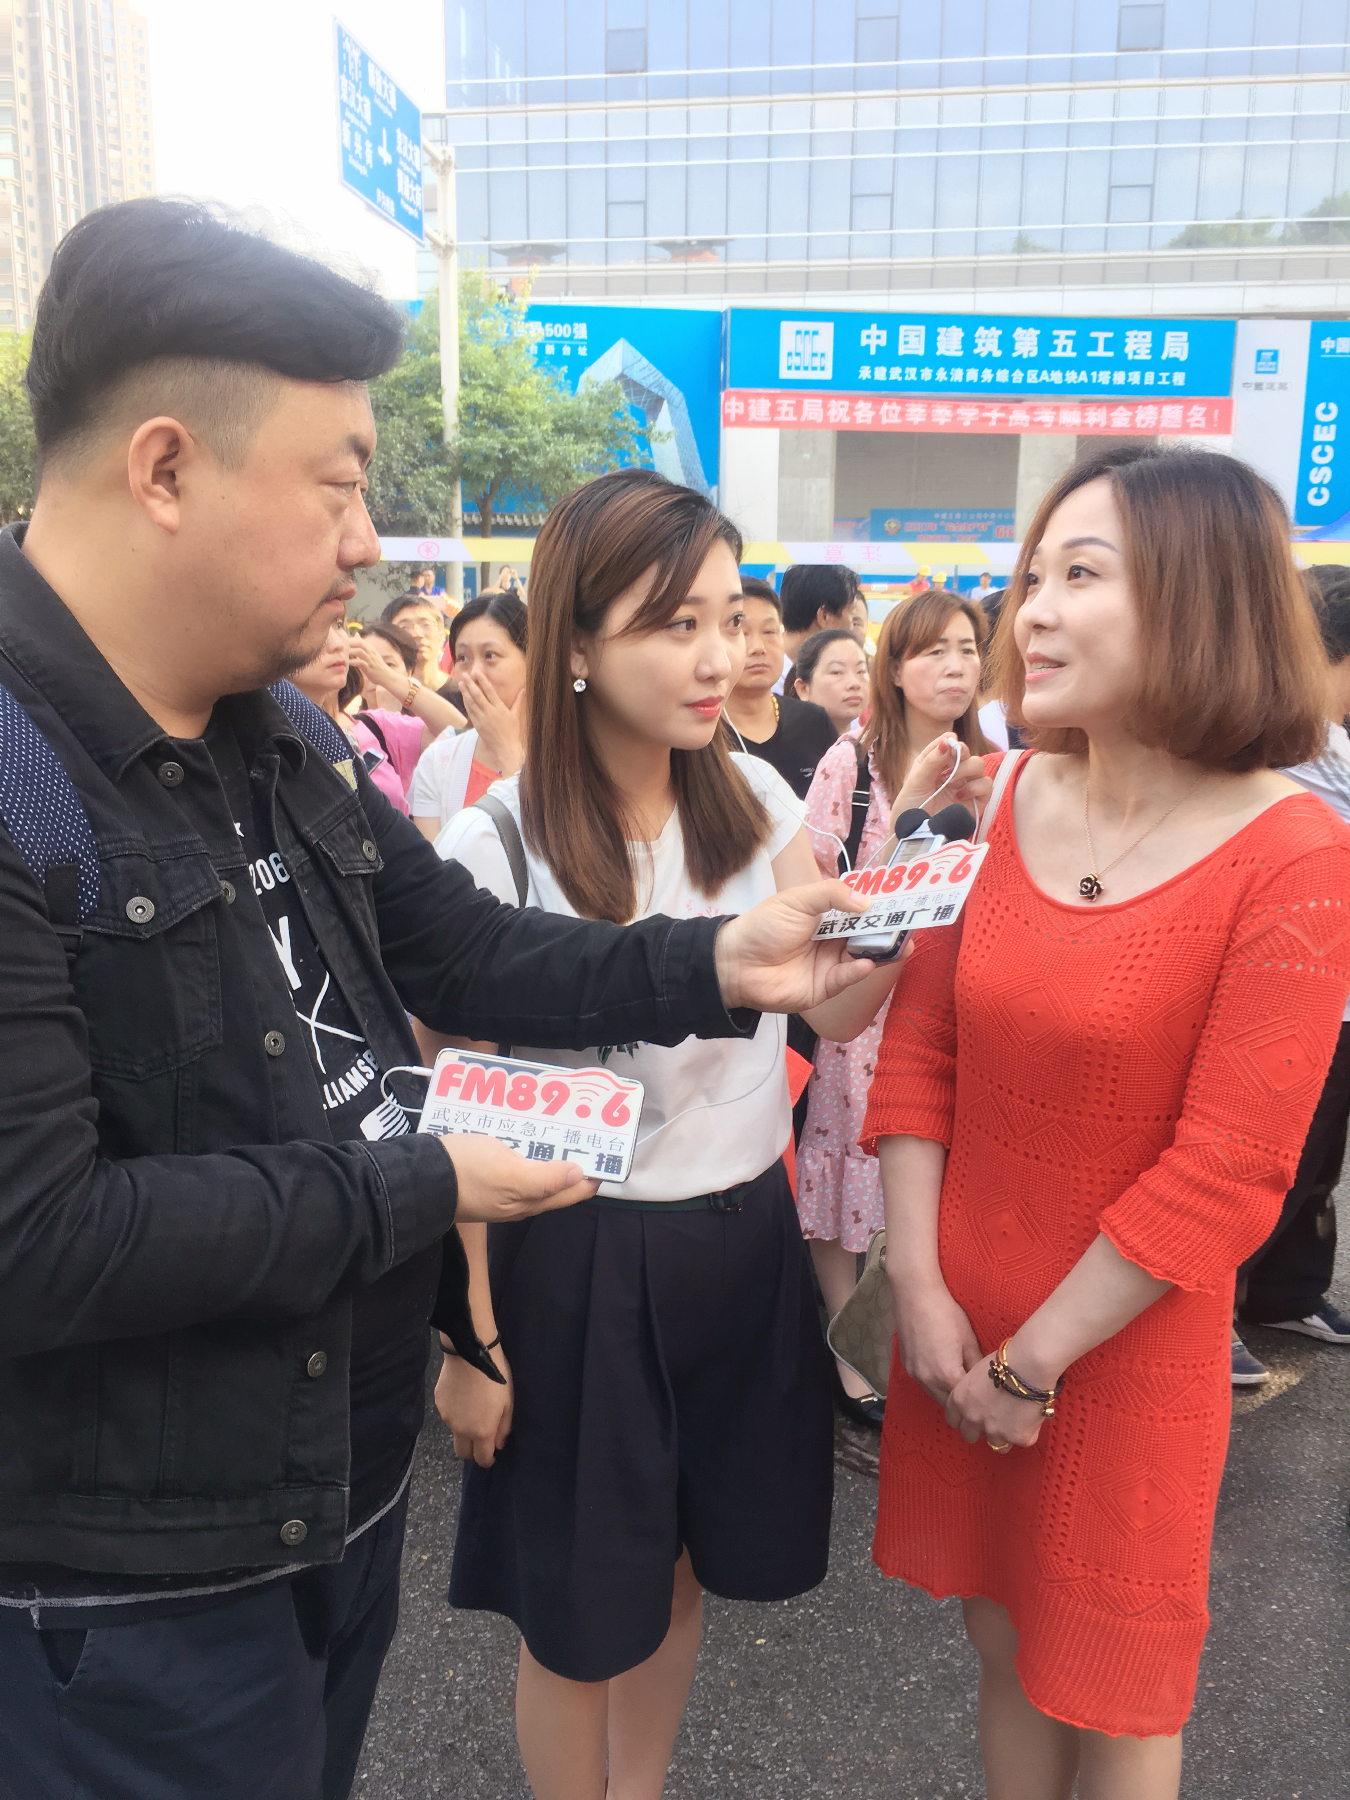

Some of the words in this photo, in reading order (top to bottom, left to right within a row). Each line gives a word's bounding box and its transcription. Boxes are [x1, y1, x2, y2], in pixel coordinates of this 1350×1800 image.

[860, 323, 1190, 361] 中国建筑第五工程局
[1307, 402, 1339, 506] CSCEC
[842, 853, 974, 896] FM89.6
[817, 904, 956, 935] 武汉交通广播
[435, 1063, 631, 1127] FM89.6
[432, 1106, 625, 1152] 武汉市应急广播电台
